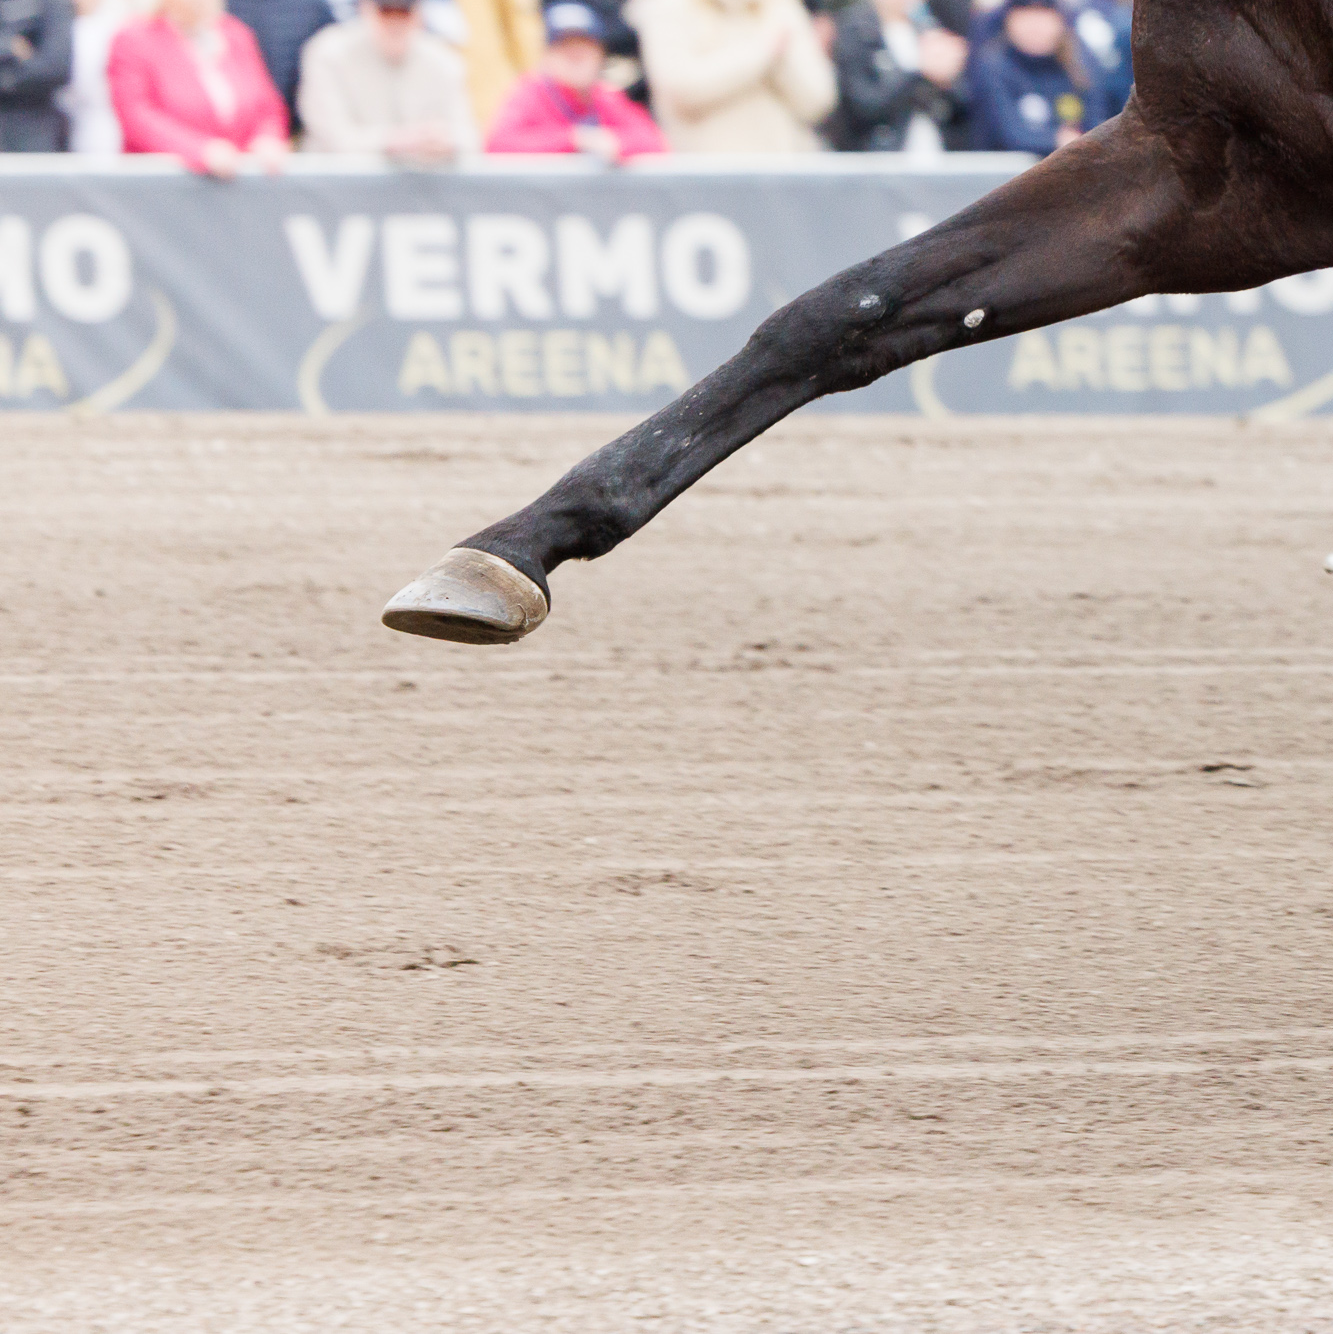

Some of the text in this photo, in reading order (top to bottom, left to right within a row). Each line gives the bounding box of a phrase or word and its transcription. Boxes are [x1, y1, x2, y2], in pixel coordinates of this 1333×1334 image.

[284, 211, 751, 322] VERMO
[399, 328, 689, 397] AREENA
[1008, 323, 1294, 392] AREENA
